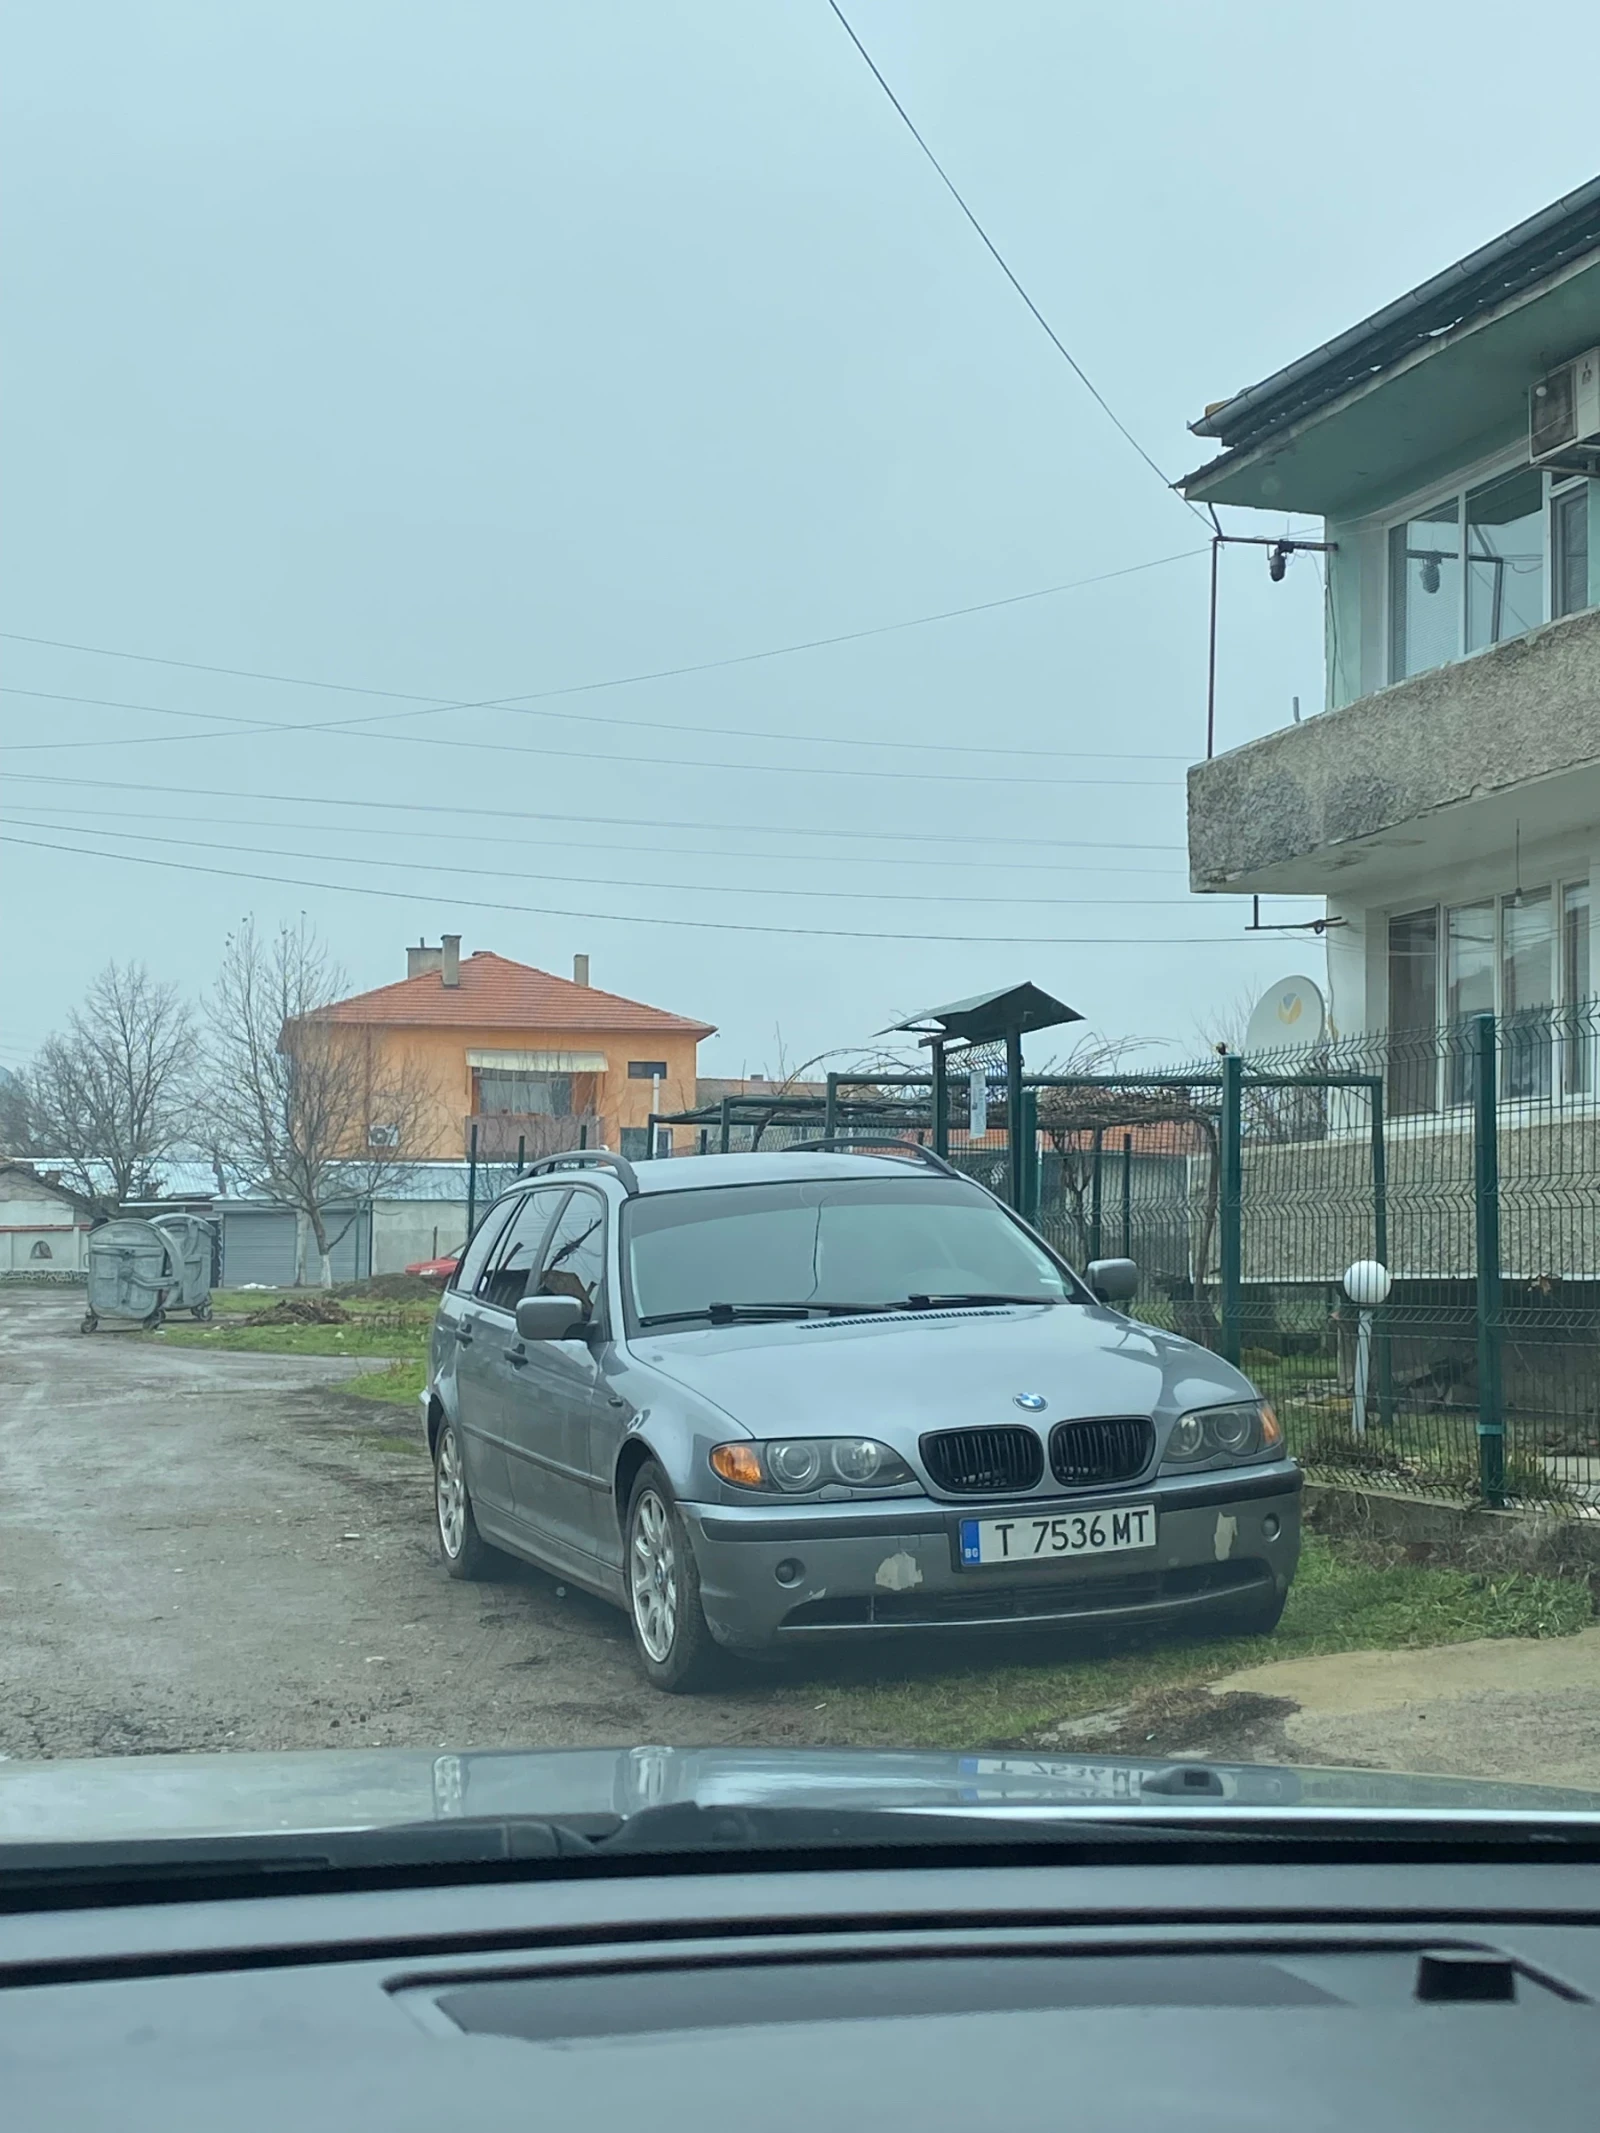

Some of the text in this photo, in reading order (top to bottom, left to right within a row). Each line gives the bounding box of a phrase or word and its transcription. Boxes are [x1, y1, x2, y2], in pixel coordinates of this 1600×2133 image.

[995, 1510, 1149, 1556] T 7536 MT
[964, 1547, 979, 1559] BG
